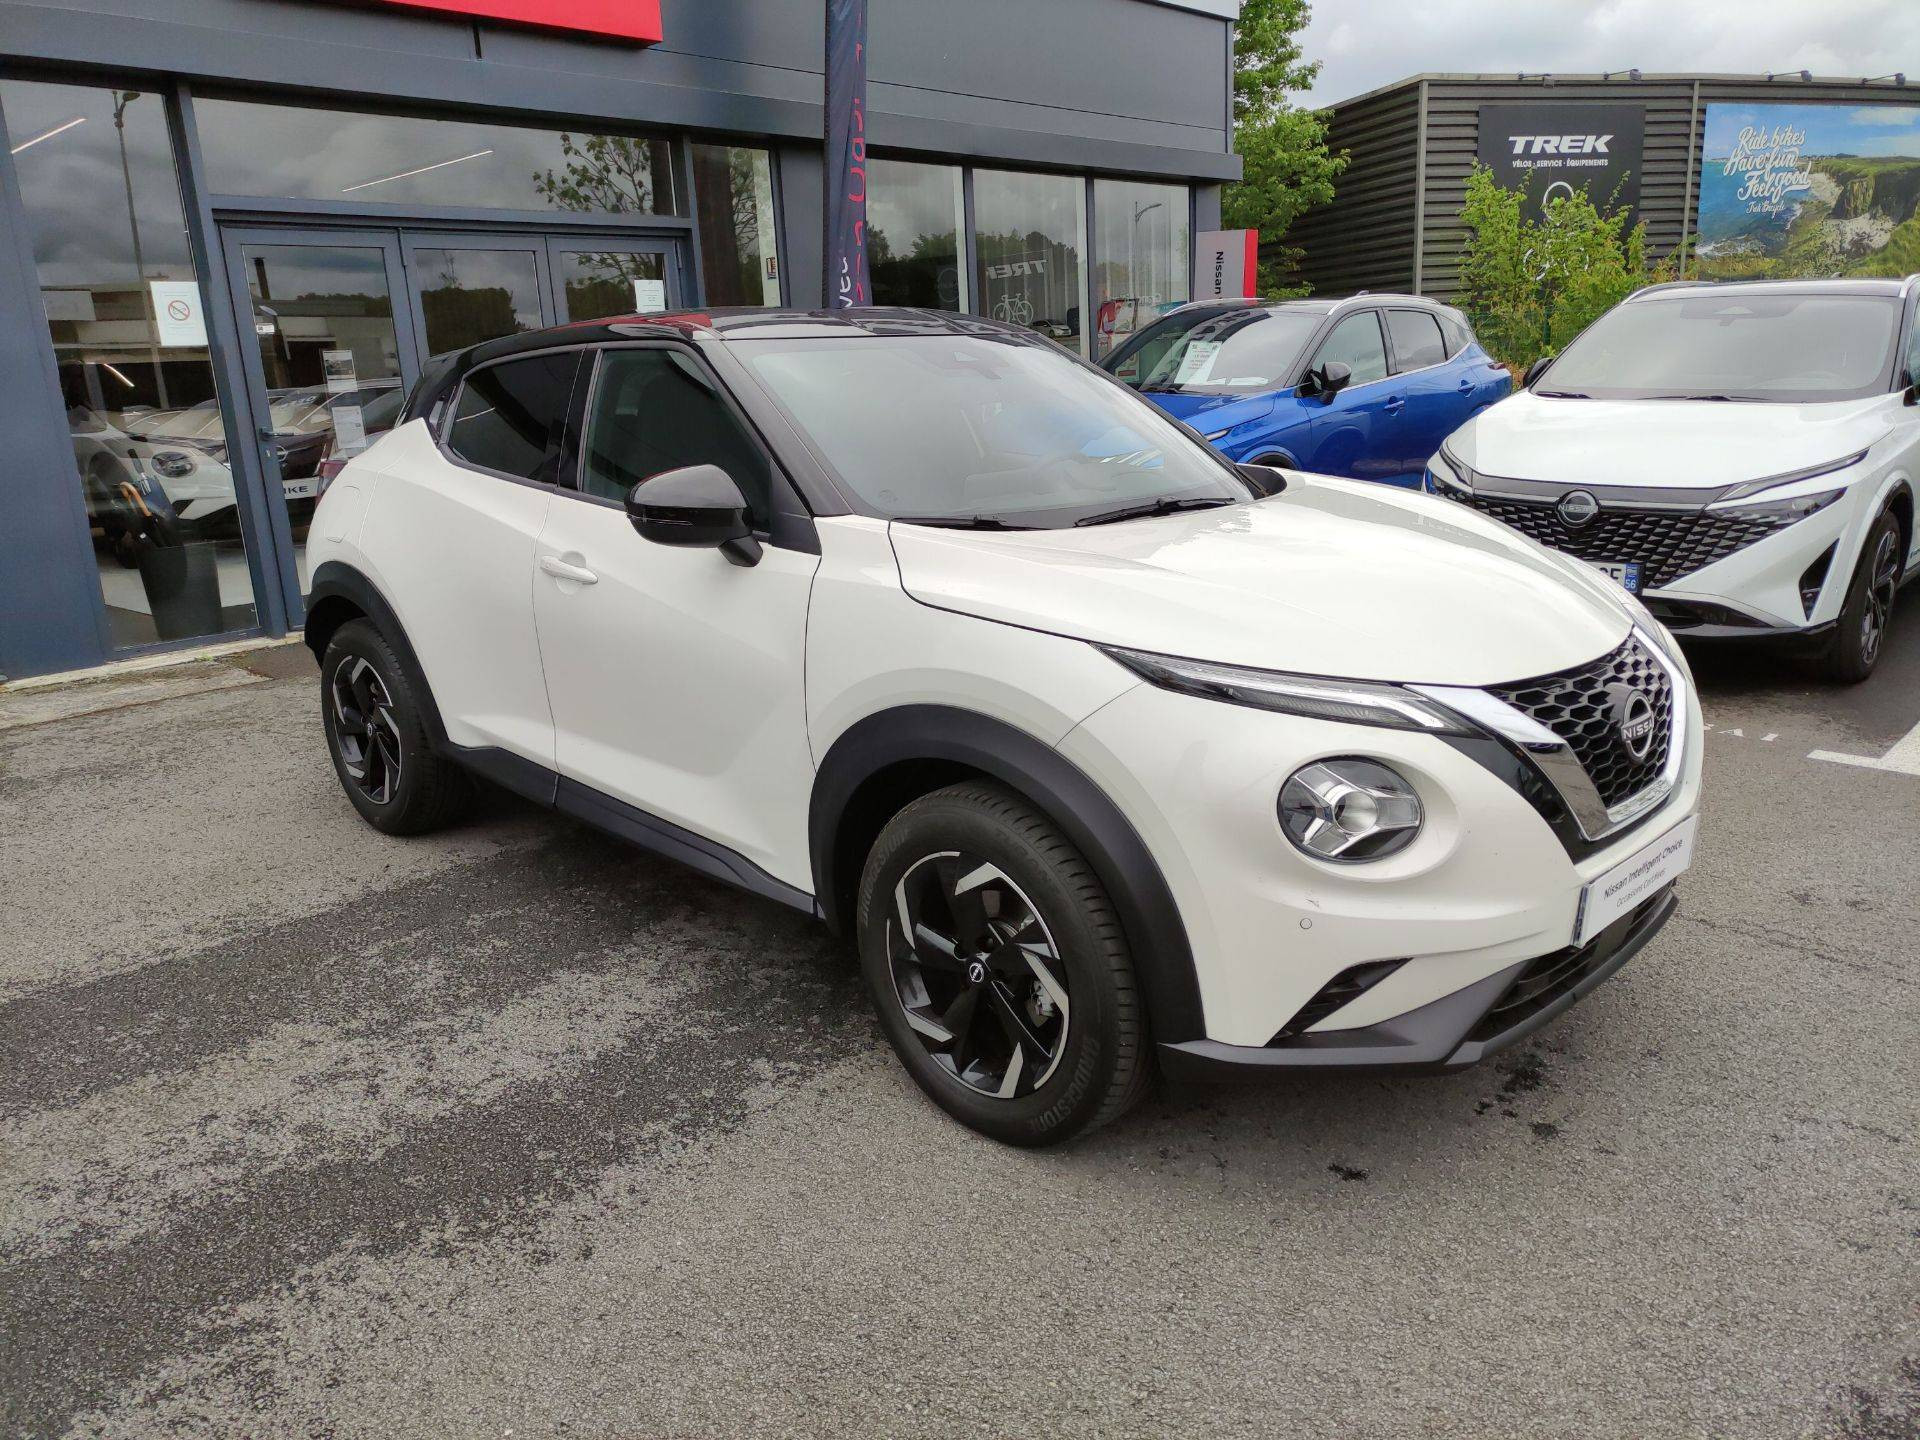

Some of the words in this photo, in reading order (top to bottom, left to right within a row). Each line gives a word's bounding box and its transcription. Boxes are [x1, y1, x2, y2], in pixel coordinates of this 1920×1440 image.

[1508, 134, 1616, 155] TREK
[1738, 125, 1769, 154] Ride
[1770, 123, 1805, 148] bikes
[1512, 158, 1532, 168] VÉLOS
[1536, 159, 1562, 168] SERVICE
[1566, 157, 1609, 167] ÉQUIPEMENTS
[1737, 170, 1774, 201] Feel
[1771, 160, 1812, 205] good
[1214, 251, 1224, 294] Nissan
[1625, 579, 1637, 589] 56
[1603, 876, 1628, 900] Nissan
[1628, 852, 1662, 881] Intelligent
[1662, 839, 1683, 859] Choice
